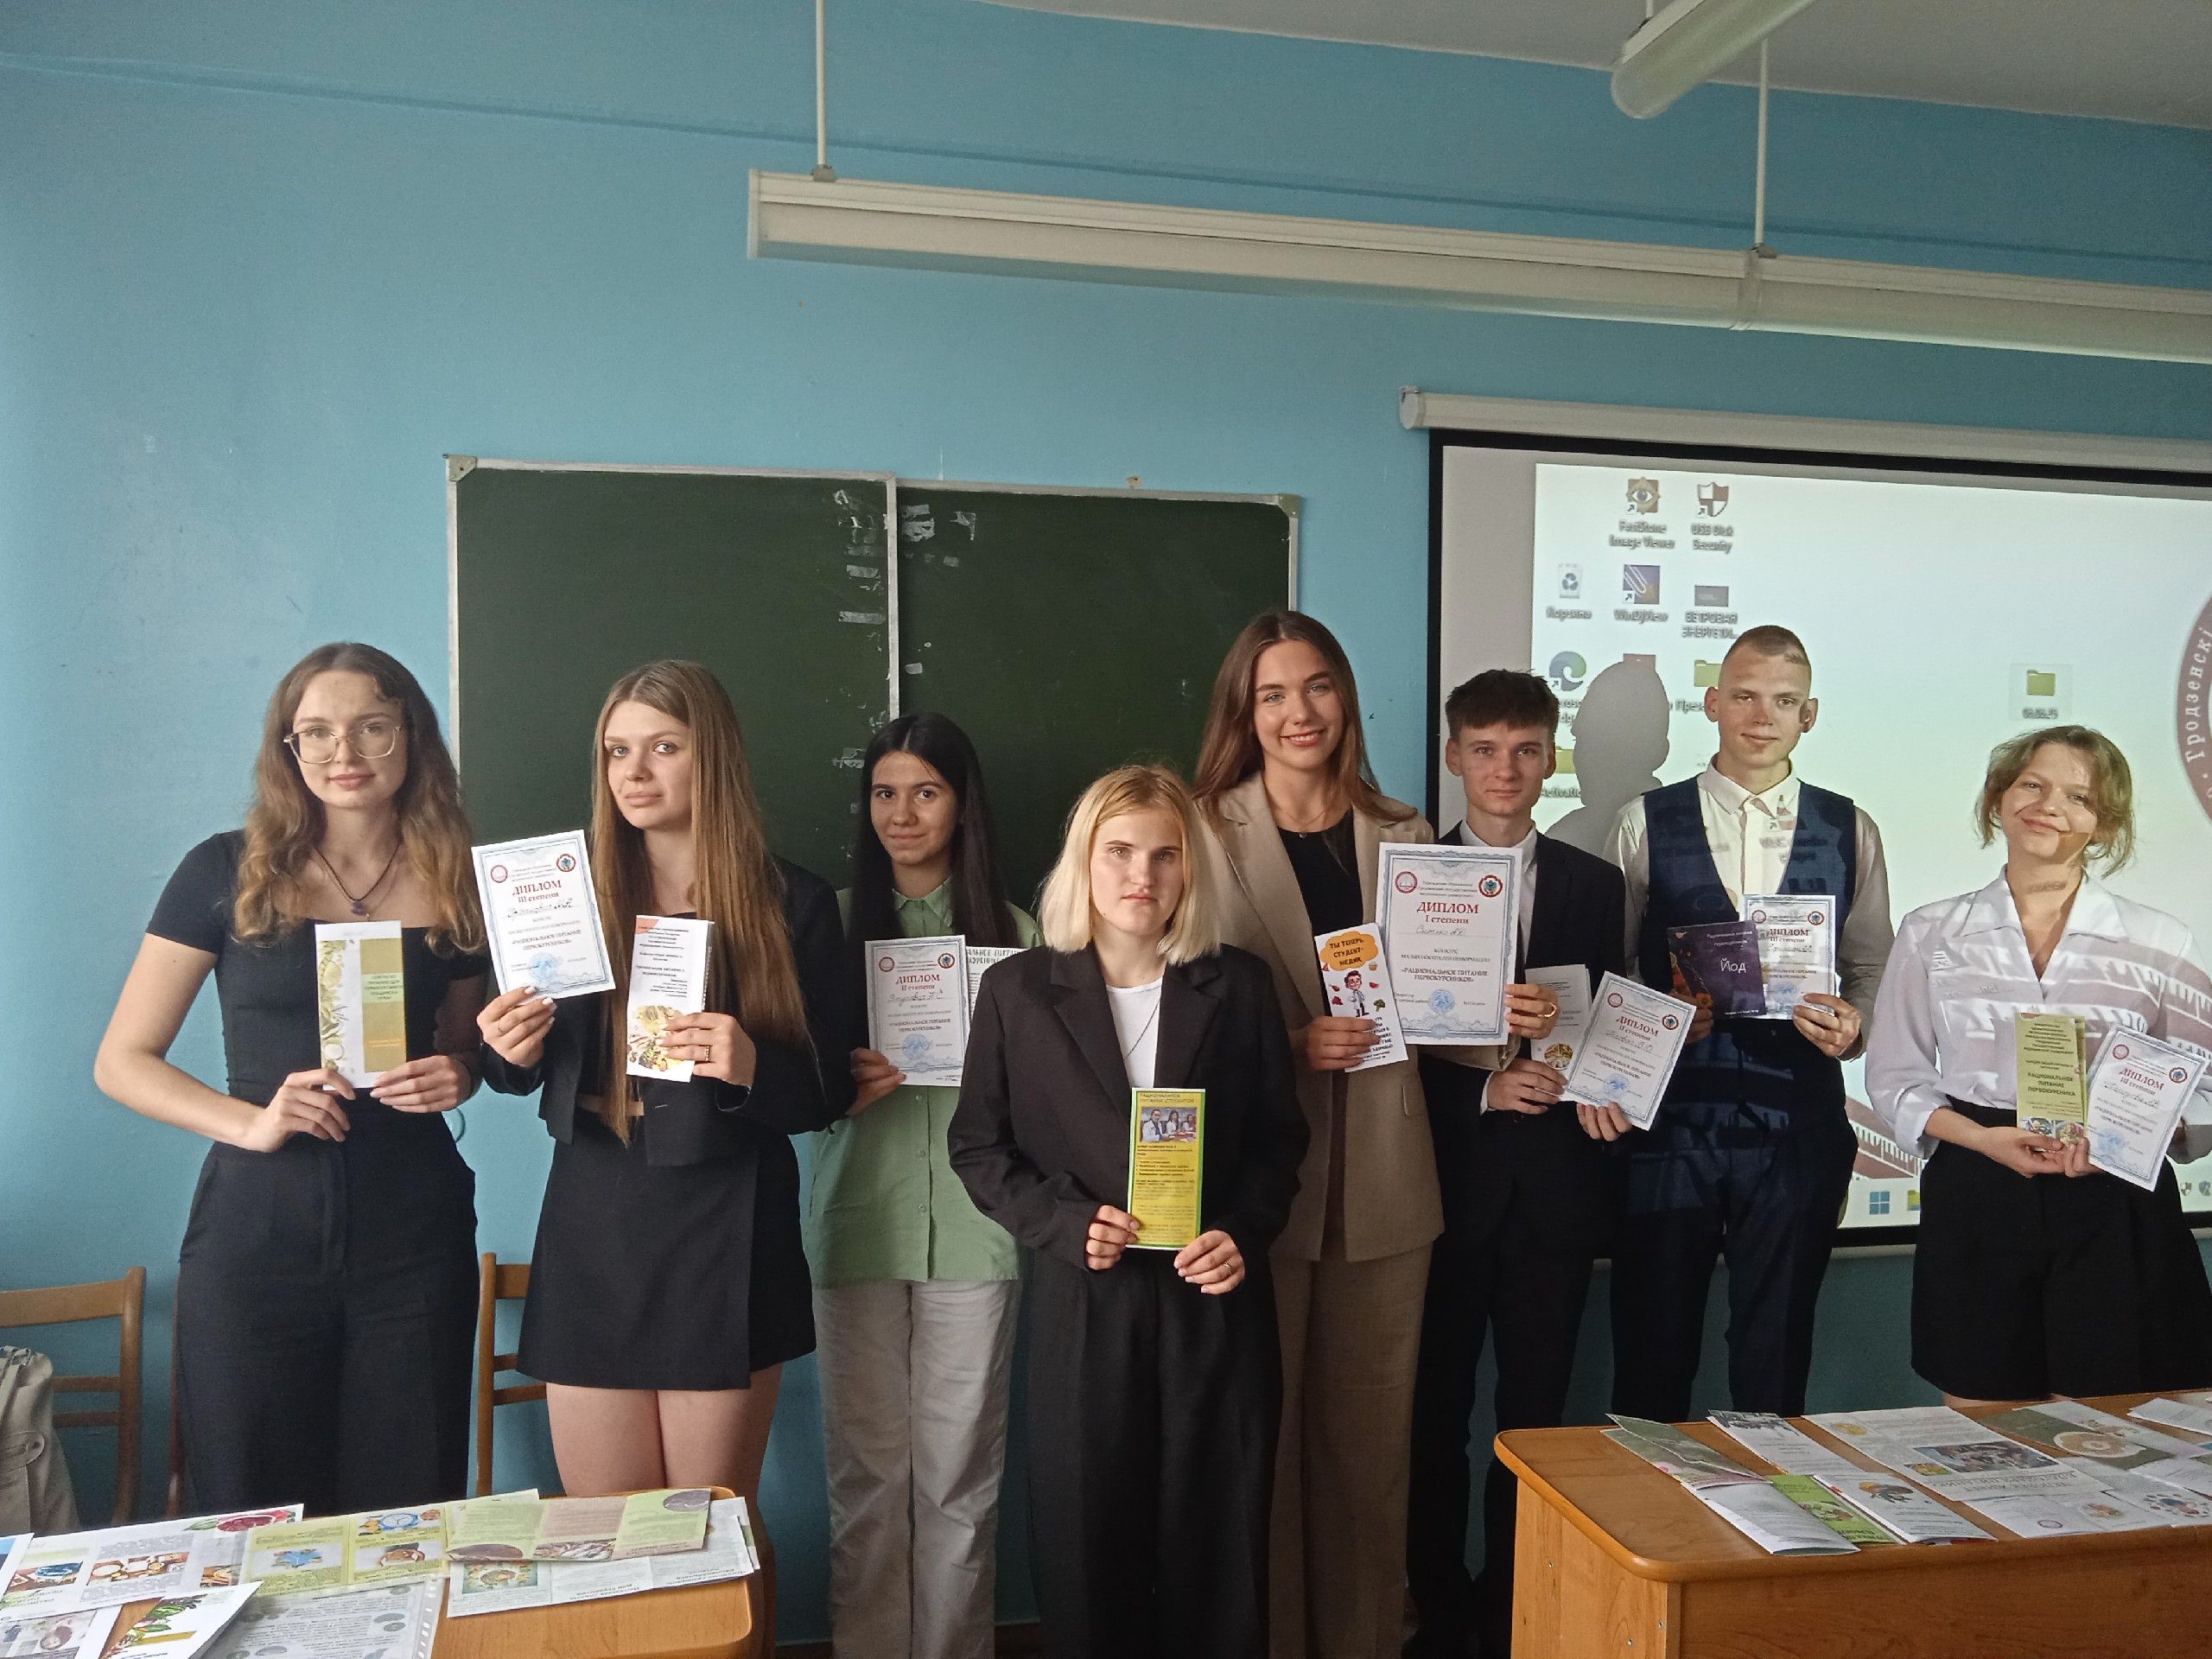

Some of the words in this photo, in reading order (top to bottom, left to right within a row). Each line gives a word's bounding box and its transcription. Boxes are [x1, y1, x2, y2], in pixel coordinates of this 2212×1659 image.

[1609, 535, 1641, 550] Image
[1643, 537, 1675, 549] Viewer
[1693, 539, 1732, 554] Security
[1547, 606, 1592, 621] Корзина
[512, 880, 562, 896] ДИПЛОМ
[1416, 901, 1479, 915] ДИПЛОМ
[1720, 957, 1747, 974] Йод
[895, 974, 941, 985] ДИПЛОМ
[1616, 1015, 1660, 1037] ДИПЛОМ
[2119, 1068, 2164, 1090] ДИПЛОМ
